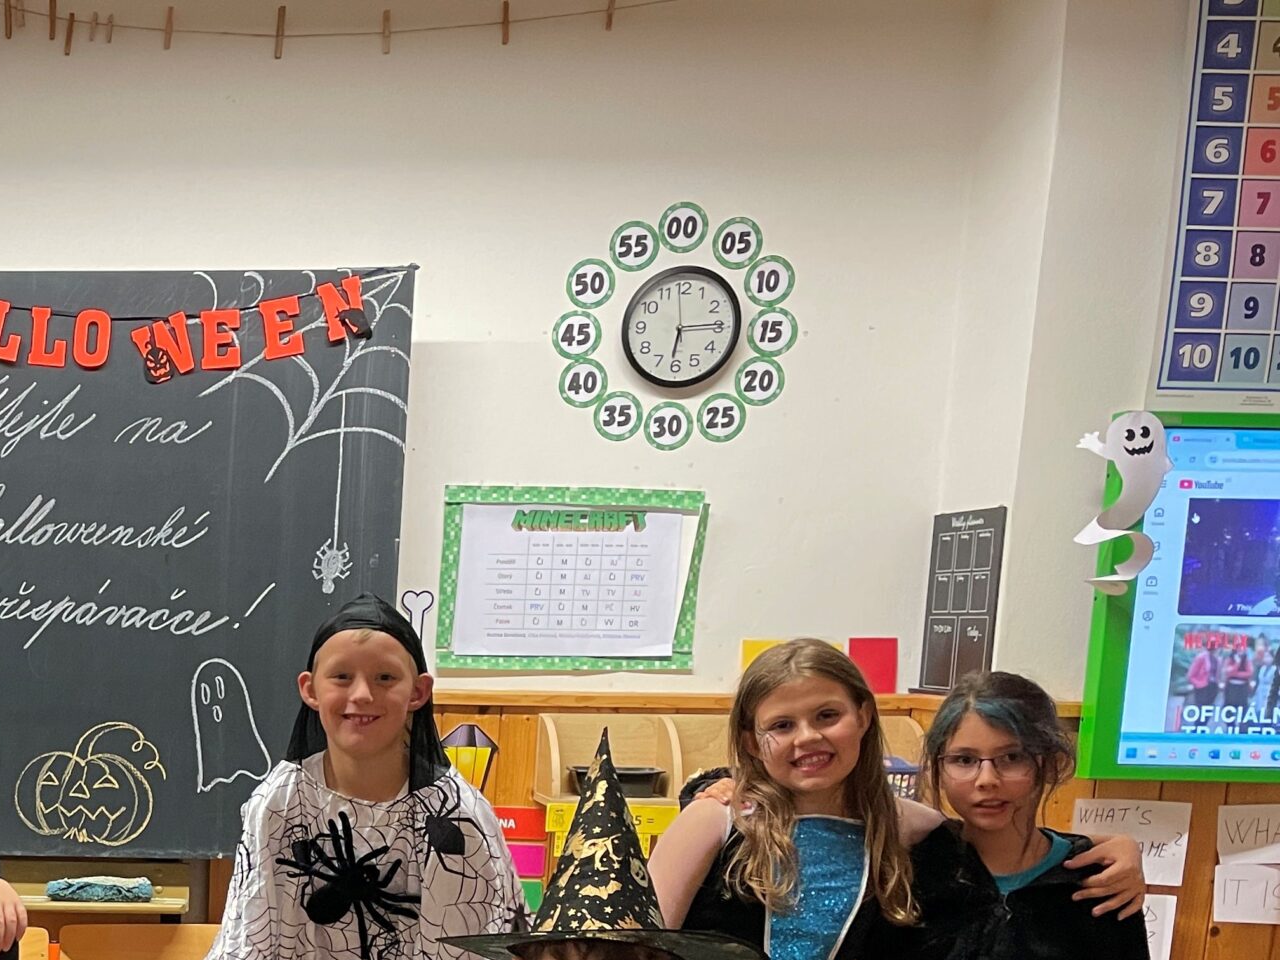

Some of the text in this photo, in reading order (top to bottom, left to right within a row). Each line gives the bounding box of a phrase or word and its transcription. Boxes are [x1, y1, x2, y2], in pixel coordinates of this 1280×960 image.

[1216, 31, 1242, 59] 4
[1211, 86, 1234, 112] 5
[1266, 86, 1280, 112] 5
[1205, 138, 1230, 164] 6
[1260, 139, 1277, 163] 6
[1201, 189, 1225, 216] 7
[1256, 191, 1271, 215] 7
[667, 215, 698, 240] 00
[618, 234, 648, 258] 55
[721, 231, 752, 254] 05
[1194, 240, 1221, 267] 8
[1249, 243, 1266, 267] 8
[574, 271, 605, 296] 50
[658, 287, 671, 300] 11
[675, 281, 692, 295] 12
[698, 286, 705, 300] 1
[756, 269, 780, 294] 10
[641, 301, 659, 314] 10
[708, 300, 720, 313] 2
[1189, 292, 1214, 319] 9
[1243, 295, 1260, 319] 9
[561, 322, 591, 347] 45
[635, 320, 646, 334] 9
[759, 320, 783, 343] 15
[639, 340, 651, 354] 8
[704, 340, 716, 353] 4
[1178, 343, 1213, 370] 10
[1230, 346, 1260, 370] 10
[654, 354, 664, 367] 7
[670, 359, 681, 373] 6
[689, 354, 700, 367] 5
[567, 371, 597, 395] 40
[743, 369, 774, 392] 20
[602, 404, 632, 427] 35
[652, 414, 682, 438] 30
[705, 406, 735, 429] 25
[114, 413, 212, 445] na
[1194, 480, 1224, 490] YouTube
[511, 509, 648, 532] MINECRAFT
[1079, 805, 1153, 826] WHAT'S
[1223, 878, 1248, 905] IT
